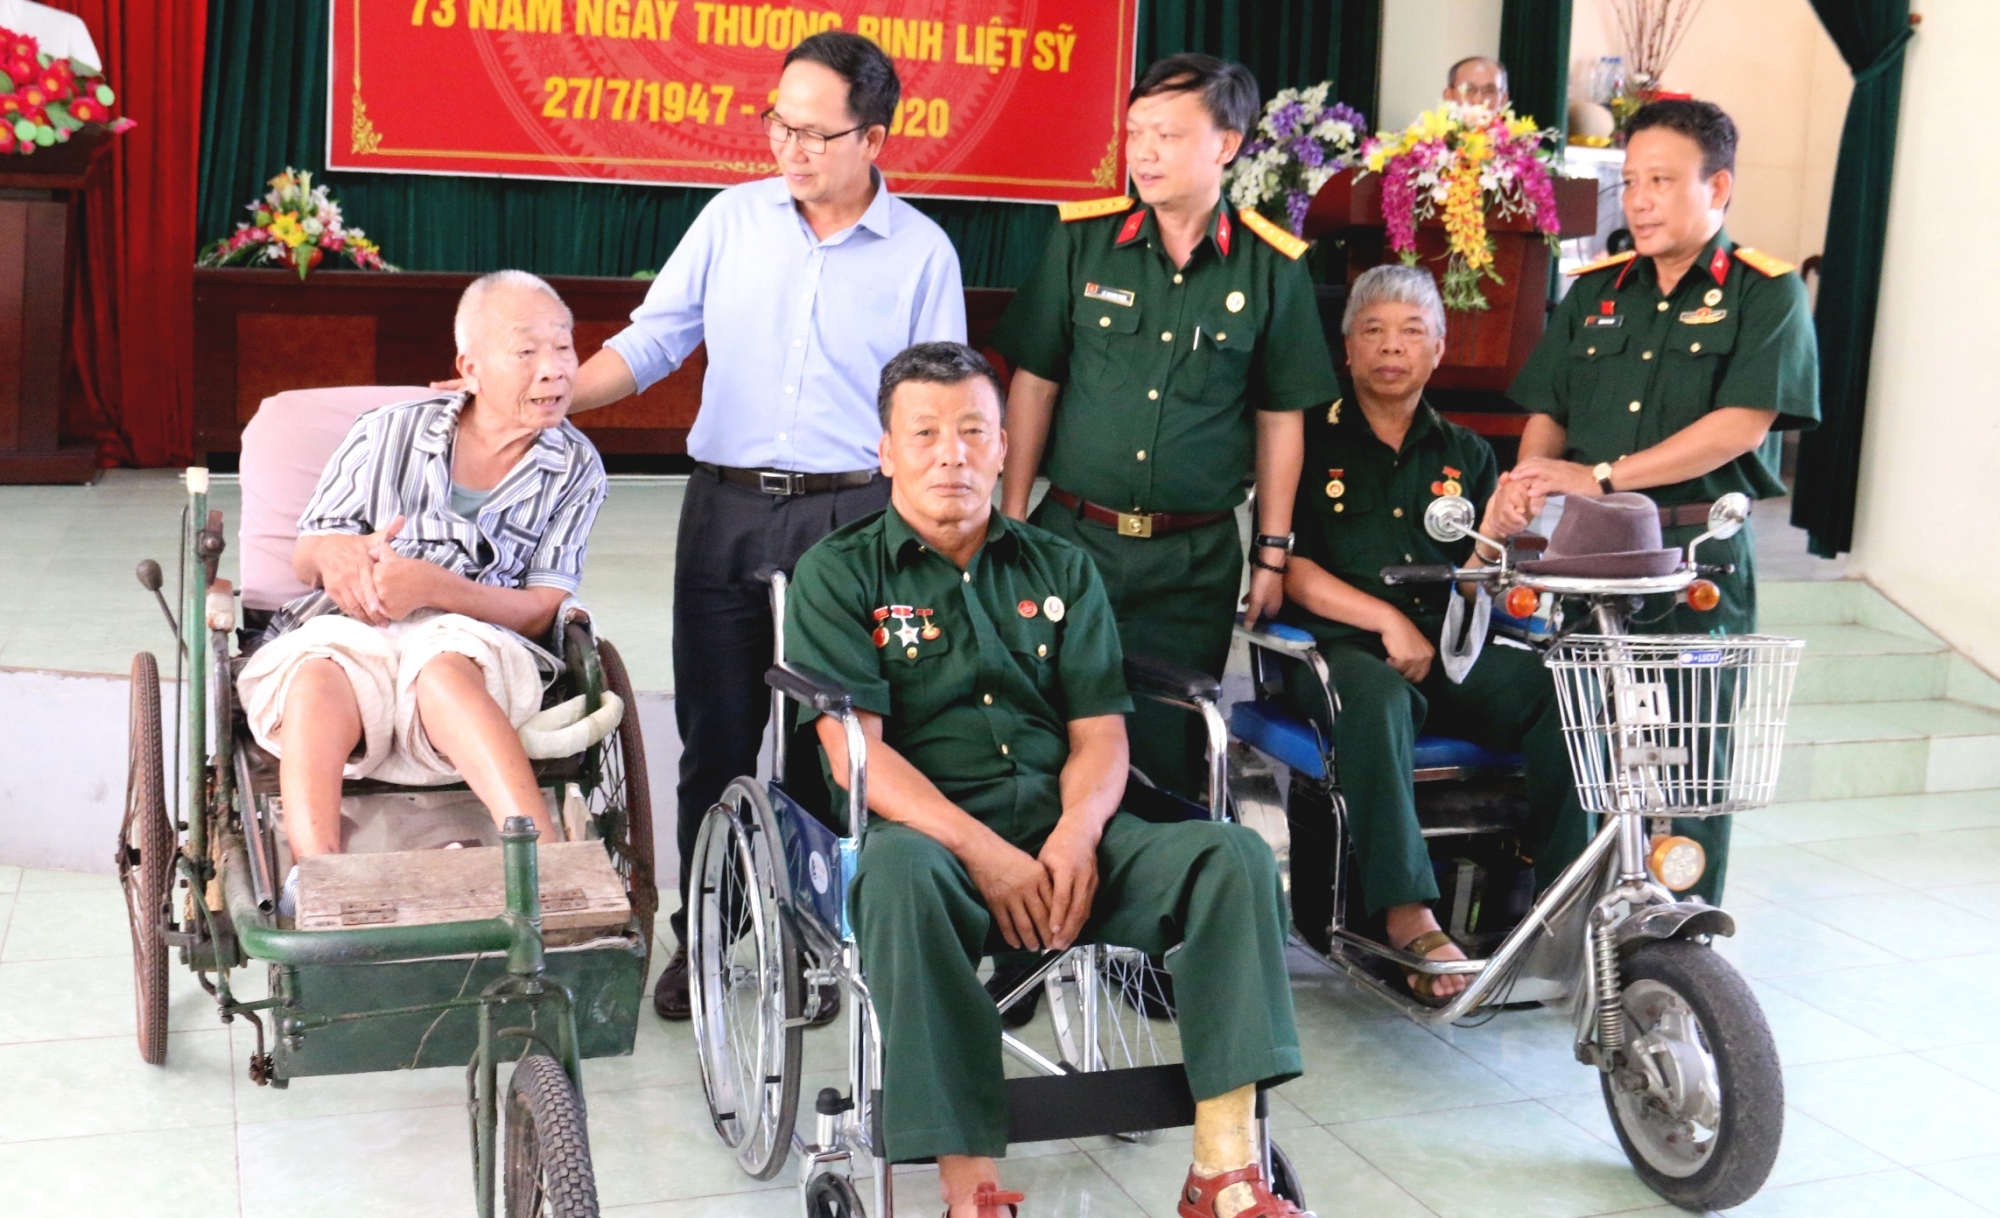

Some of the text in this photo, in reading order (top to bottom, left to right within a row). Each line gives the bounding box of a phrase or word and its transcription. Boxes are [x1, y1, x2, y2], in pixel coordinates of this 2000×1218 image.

[411, 0, 457, 27] 73
[857, 15, 944, 62] BINH
[956, 16, 1027, 74] LIỆT
[1032, 23, 1077, 73] SỸ
[542, 76, 734, 125] 27/7/1947
